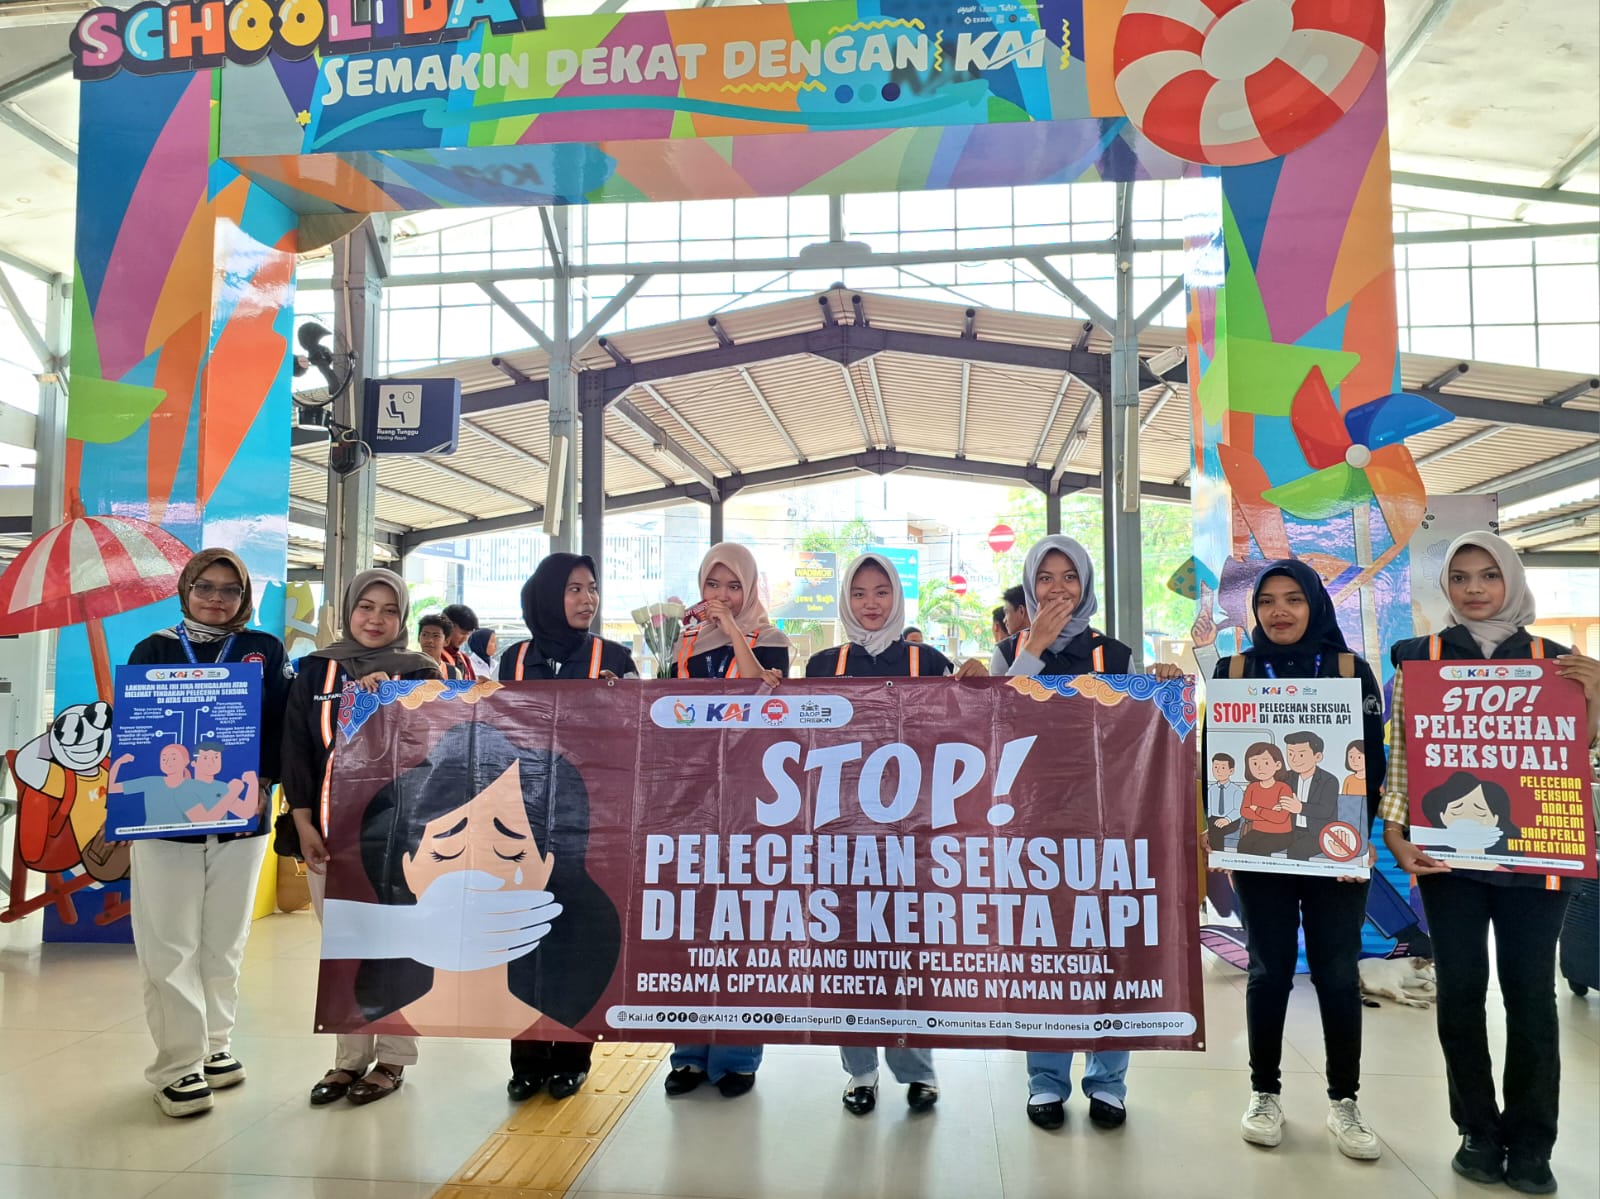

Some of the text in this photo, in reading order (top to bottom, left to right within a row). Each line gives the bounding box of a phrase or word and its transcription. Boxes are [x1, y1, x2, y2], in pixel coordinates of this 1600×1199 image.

[78, 0, 544, 66] SCHOOLIDA
[321, 29, 1046, 106] SEMAKIN DEKAT DENGAN KAI
[1467, 669, 1489, 677] KAI
[1259, 702, 1351, 714] PELECEHAN SEKSUAL
[1442, 685, 1542, 713] STOP!
[706, 702, 751, 722] KAI
[821, 707, 831, 717] 3
[1213, 702, 1257, 724] STOP!
[1259, 714, 1351, 725] DI ATAS KERETA API
[1414, 714, 1576, 741] PELECEHAN
[1425, 743, 1568, 771] SEKSUAL!
[756, 735, 1038, 830] STOP!
[1520, 775, 1582, 790] PELECEHAN
[1534, 789, 1583, 803] SEKSUAL
[1542, 802, 1583, 816] ADALAH
[1536, 814, 1585, 829] PANDEMI
[1521, 827, 1585, 842] YANG PERLU
[1507, 838, 1586, 856] KITA HENTIKAN
[644, 833, 1156, 890] PELECEHAN SEKSUAL
[641, 889, 1159, 948] DI ATAS KERETA API
[687, 948, 1114, 974] TIDAK ADA RUANG UNTUK PELECEHAN SEKSUAL
[637, 973, 1163, 1001] BERSAMA CIPTAKAN KERETA API YANG NYAMAN DAN AMAN
[628, 1013, 654, 1022] Kai.id
[699, 1014, 738, 1024] @KAI121
[785, 1014, 842, 1025] EdanSepurID
[938, 1018, 987, 1029] Komunitas
[989, 1019, 1012, 1029] Edan
[1015, 1020, 1042, 1032] Sepur
[1045, 1021, 1090, 1031] Indonesia
[1124, 1019, 1185, 1030] Cirebonspoor
